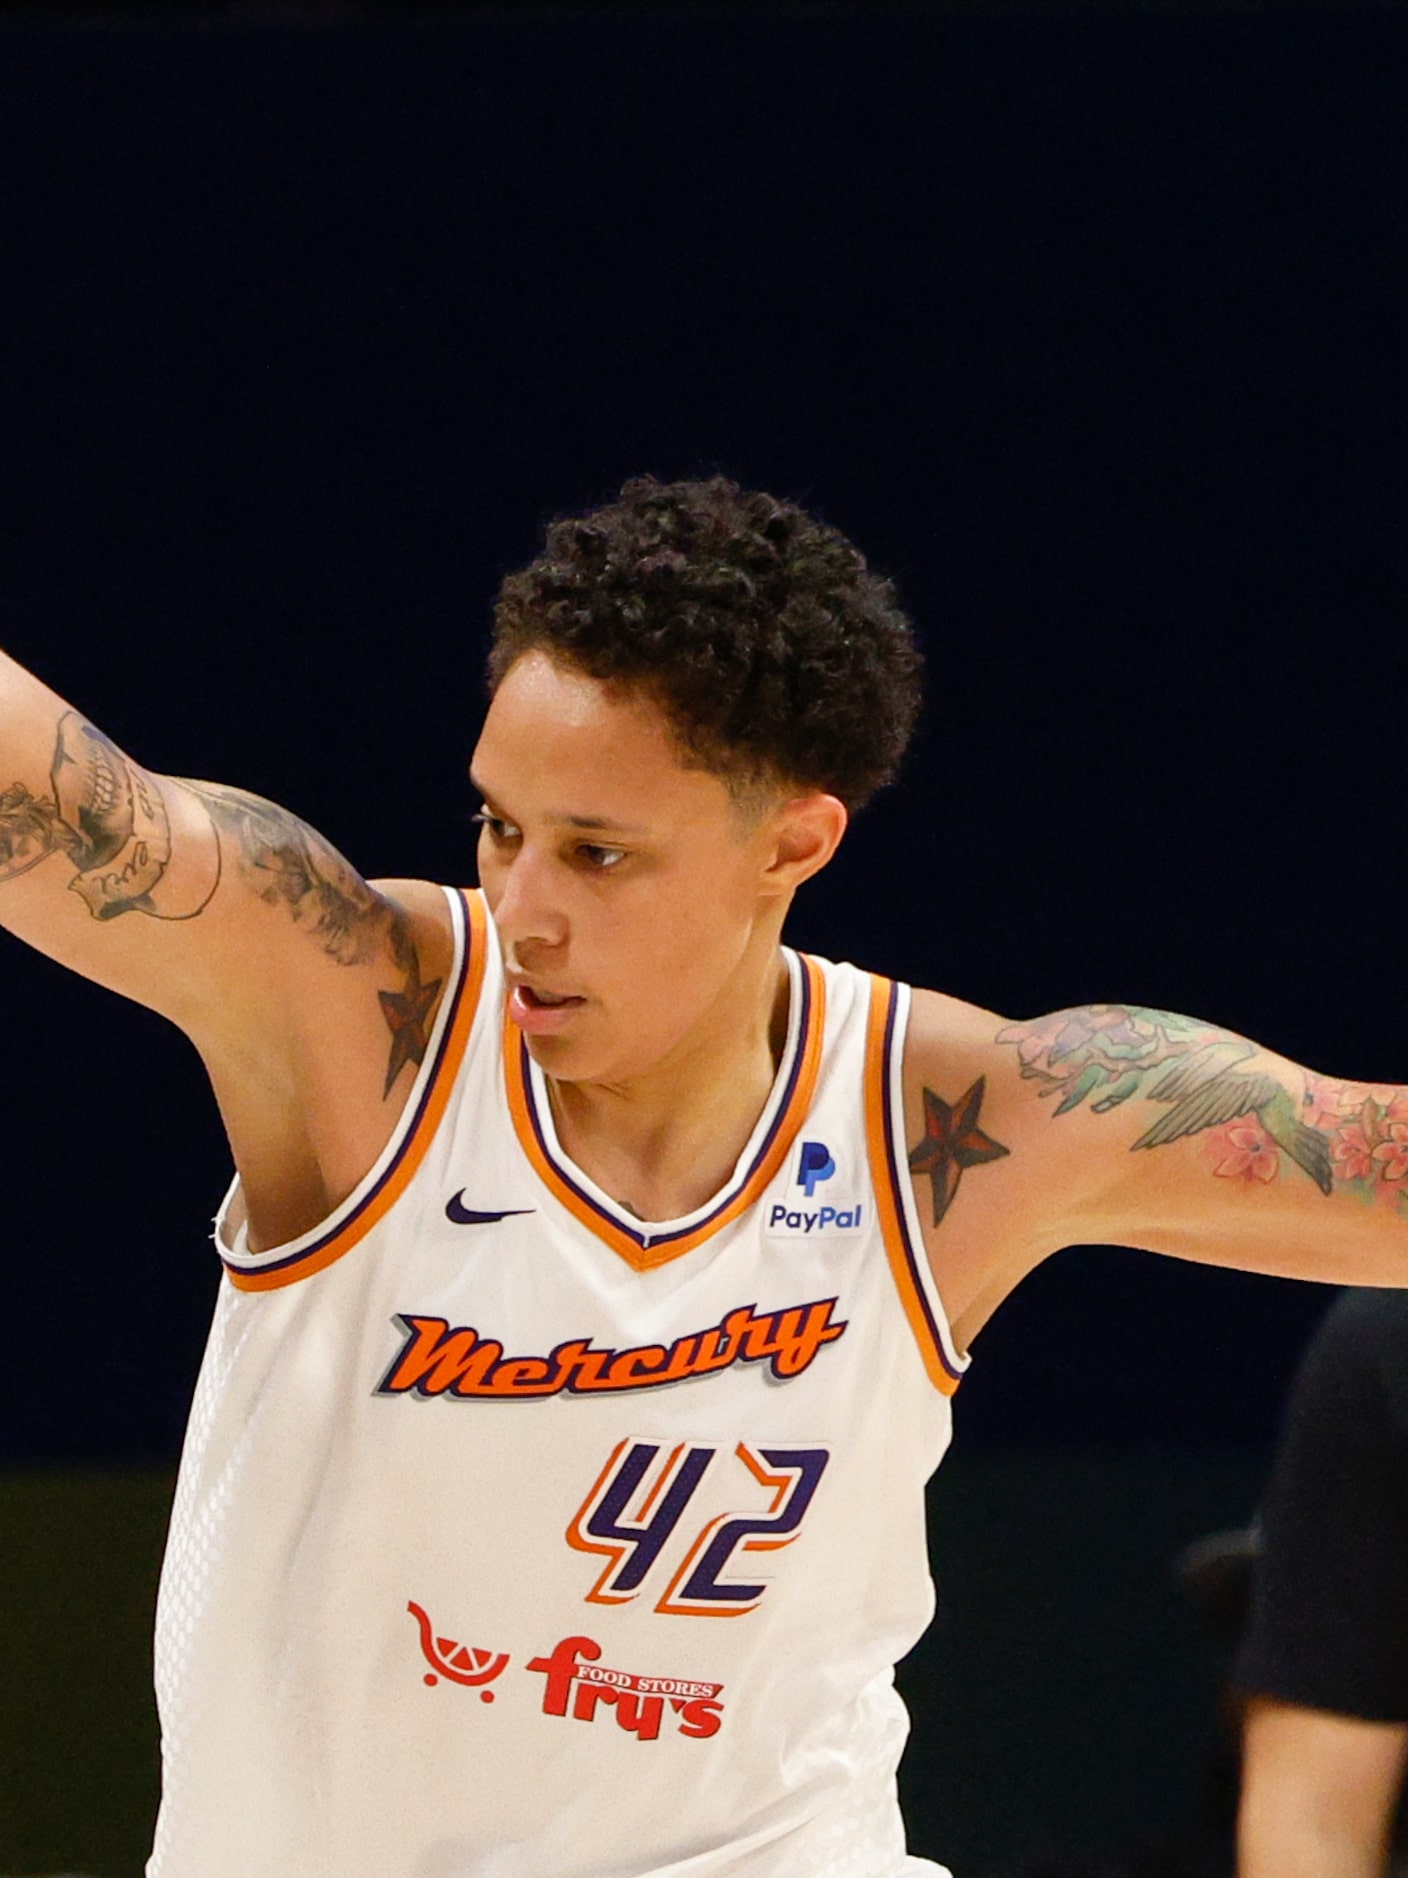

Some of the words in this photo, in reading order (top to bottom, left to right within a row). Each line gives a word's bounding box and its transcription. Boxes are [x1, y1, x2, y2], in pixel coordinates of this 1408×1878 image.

[769, 1204, 862, 1233] PayPal
[371, 1297, 849, 1402] Mercury
[564, 1436, 831, 1618] 42
[525, 1636, 725, 1741] fry's
[577, 1666, 632, 1688] FOOD
[637, 1678, 714, 1697] STORES
